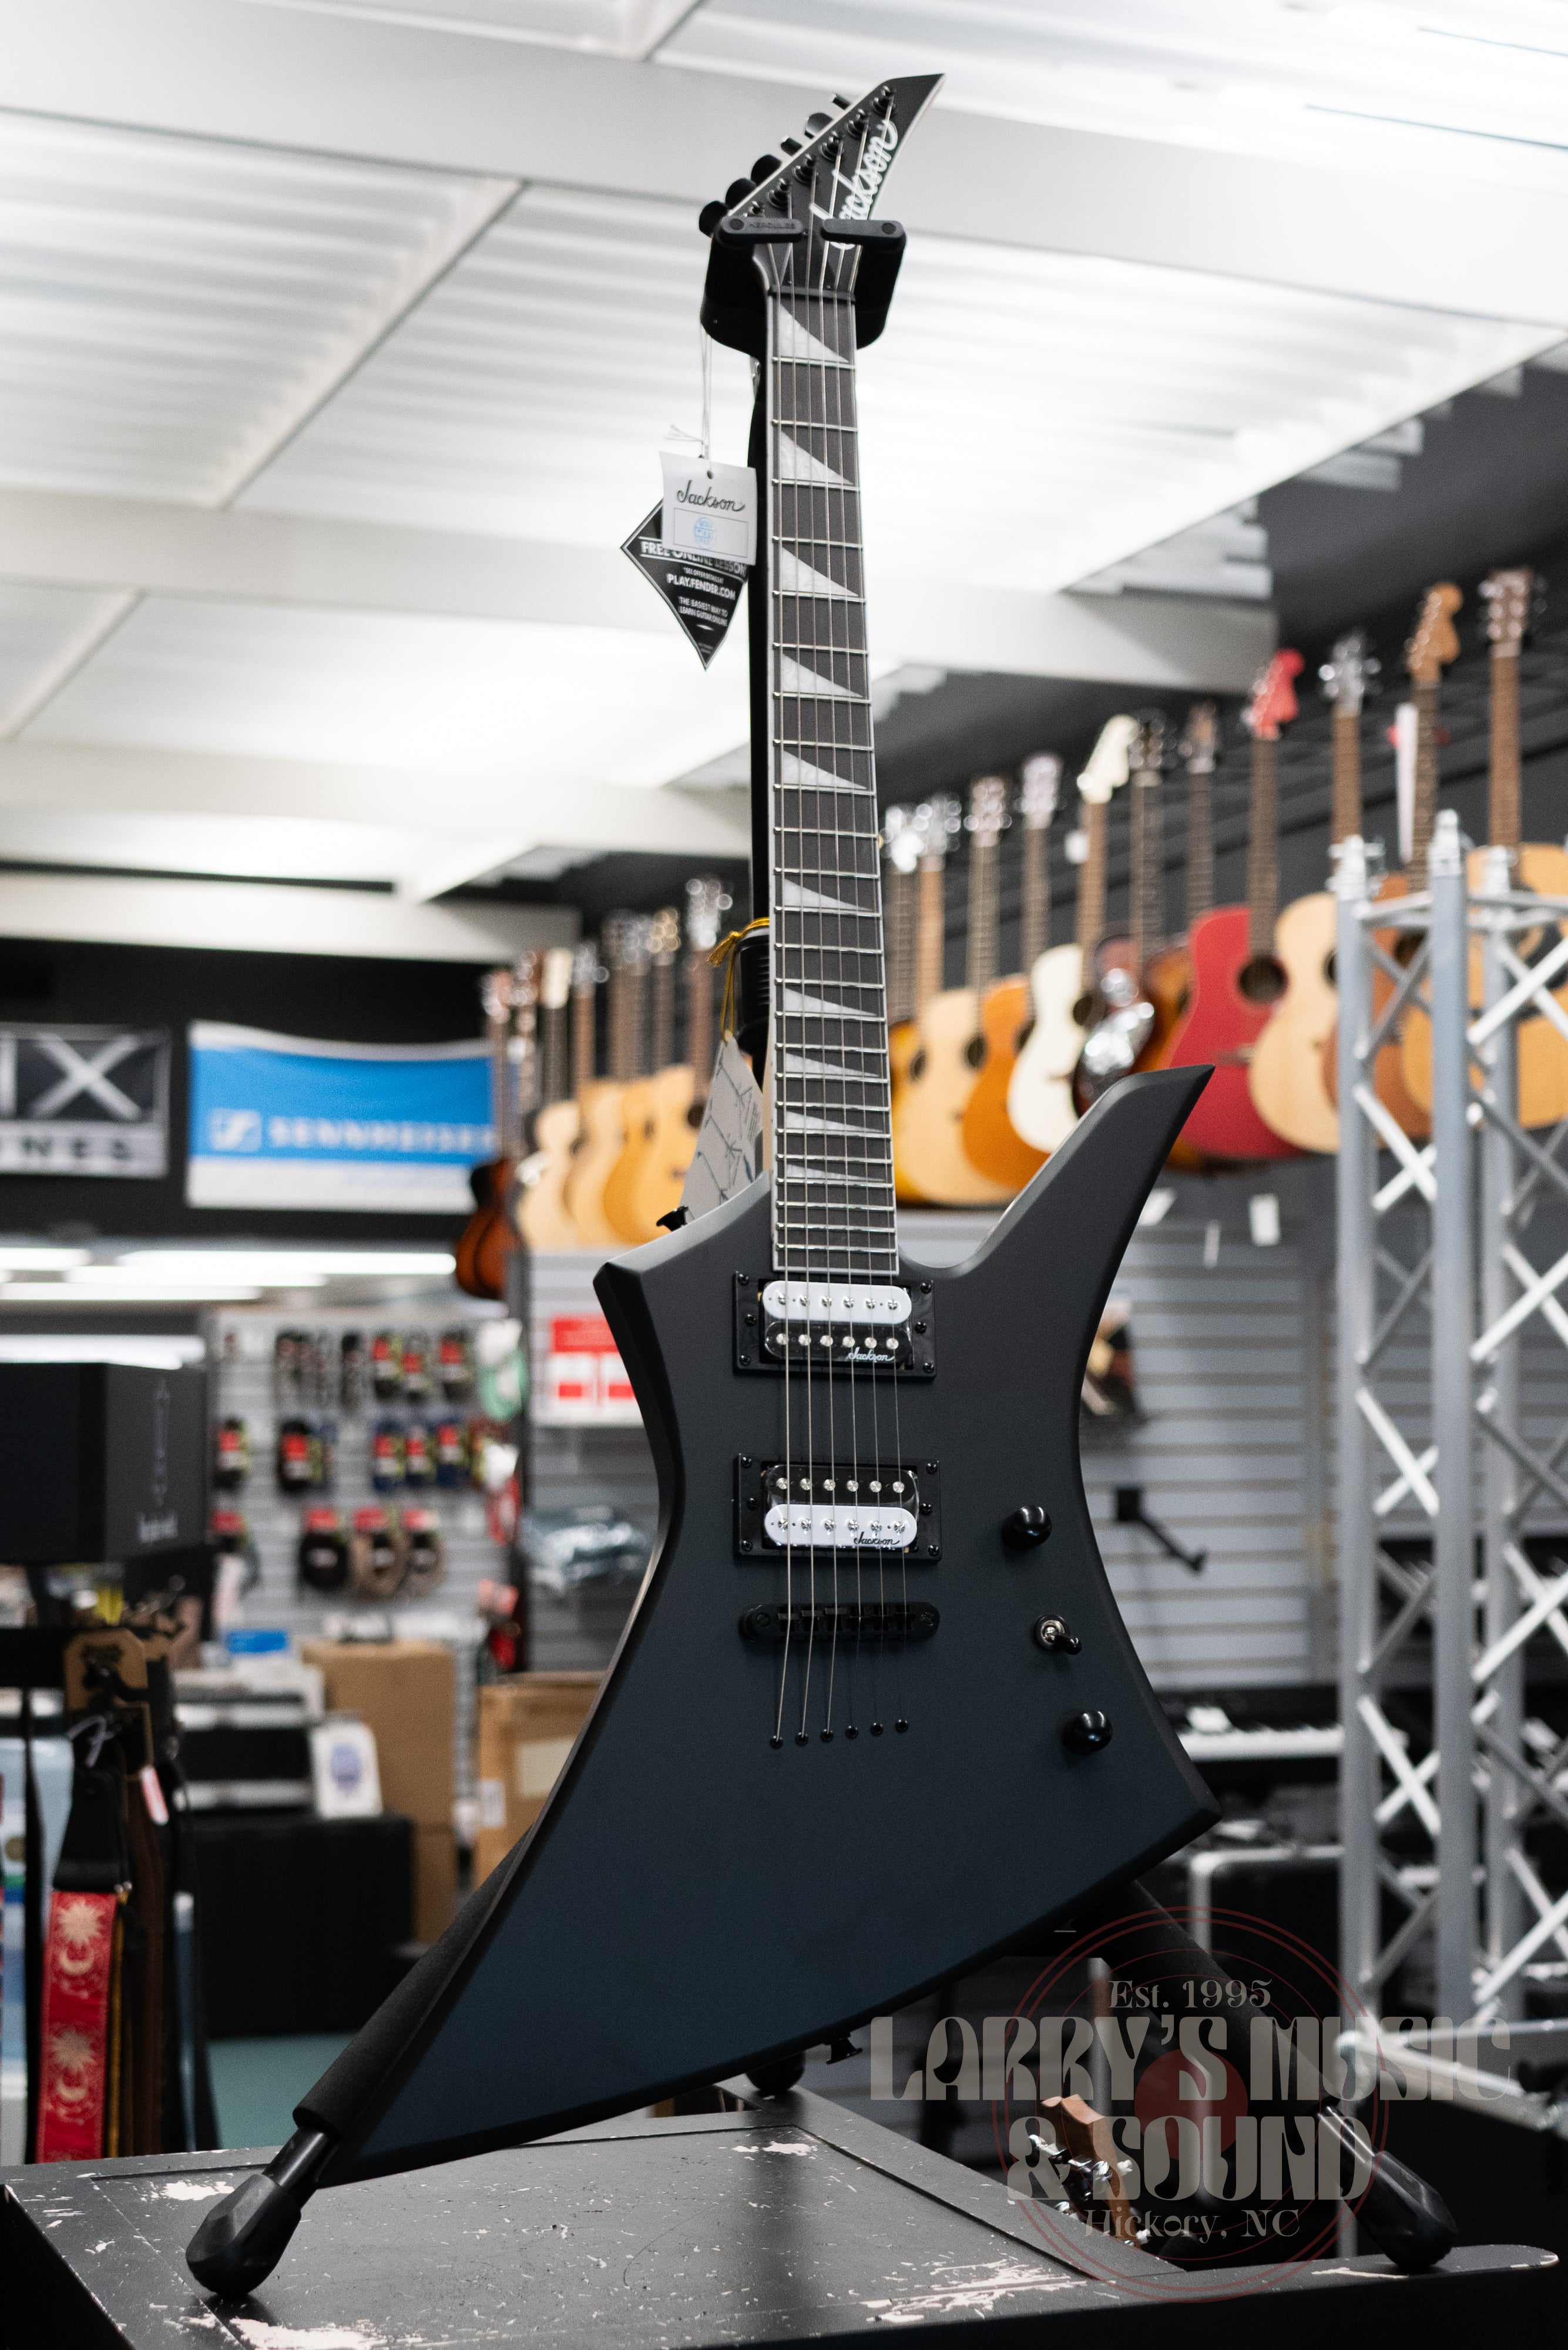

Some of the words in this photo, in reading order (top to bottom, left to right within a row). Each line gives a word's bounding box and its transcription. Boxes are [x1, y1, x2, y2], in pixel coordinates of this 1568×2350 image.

[677, 479, 746, 512] Jackson
[640, 541, 670, 557] FREE
[666, 573, 736, 600] PLAY.FENDER.COM
[678, 596, 690, 606] THE
[691, 599, 710, 611] EASIEST
[710, 605, 721, 615] WAY
[721, 608, 728, 617] TO
[679, 606, 696, 616] LEARN
[847, 1346, 895, 1362] Jackson
[854, 1531, 900, 1546] Jackson
